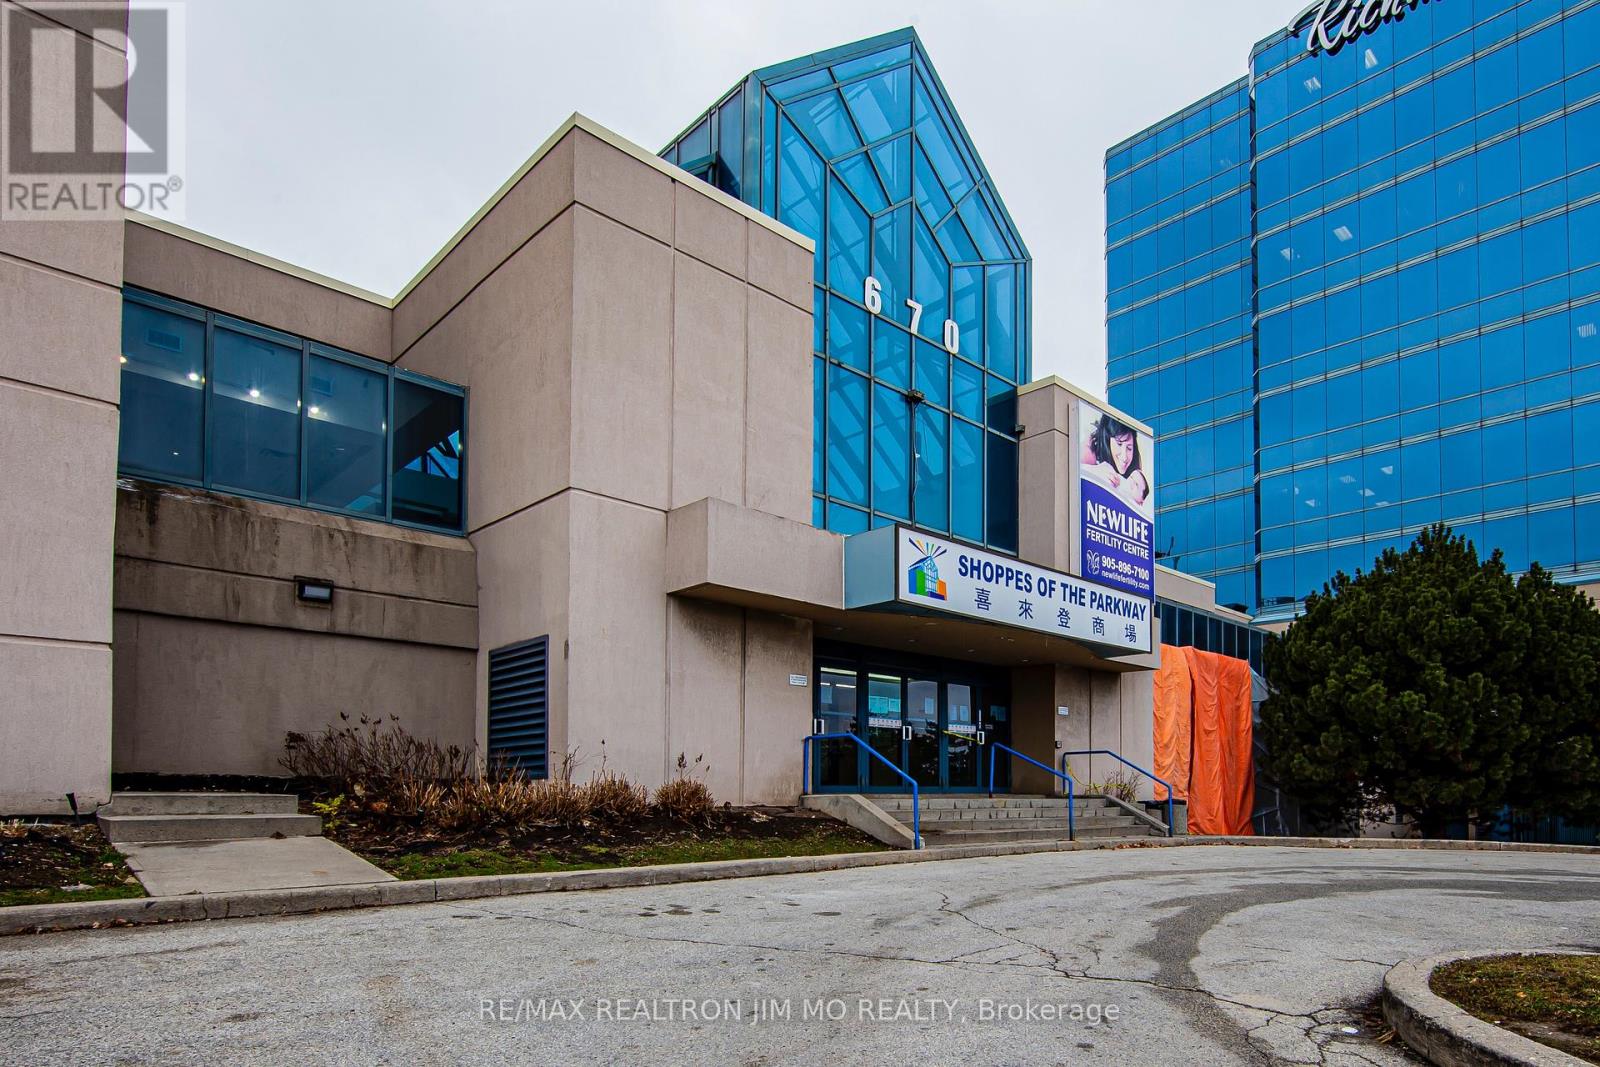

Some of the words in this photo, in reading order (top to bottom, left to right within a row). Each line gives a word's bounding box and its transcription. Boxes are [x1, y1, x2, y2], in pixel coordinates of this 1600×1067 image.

[1086, 499, 1149, 543] NEWLIFE
[1086, 528, 1121, 550] FERTILITY
[1122, 541, 1149, 560] CENTRE
[958, 554, 1033, 593] SHOPPES
[1037, 576, 1057, 599] OF
[1060, 582, 1086, 607] THE
[1090, 590, 1147, 622] PARKWAY
[1101, 555, 1149, 581] 905-896-7100
[974, 587, 1137, 643] 喜來登商場
